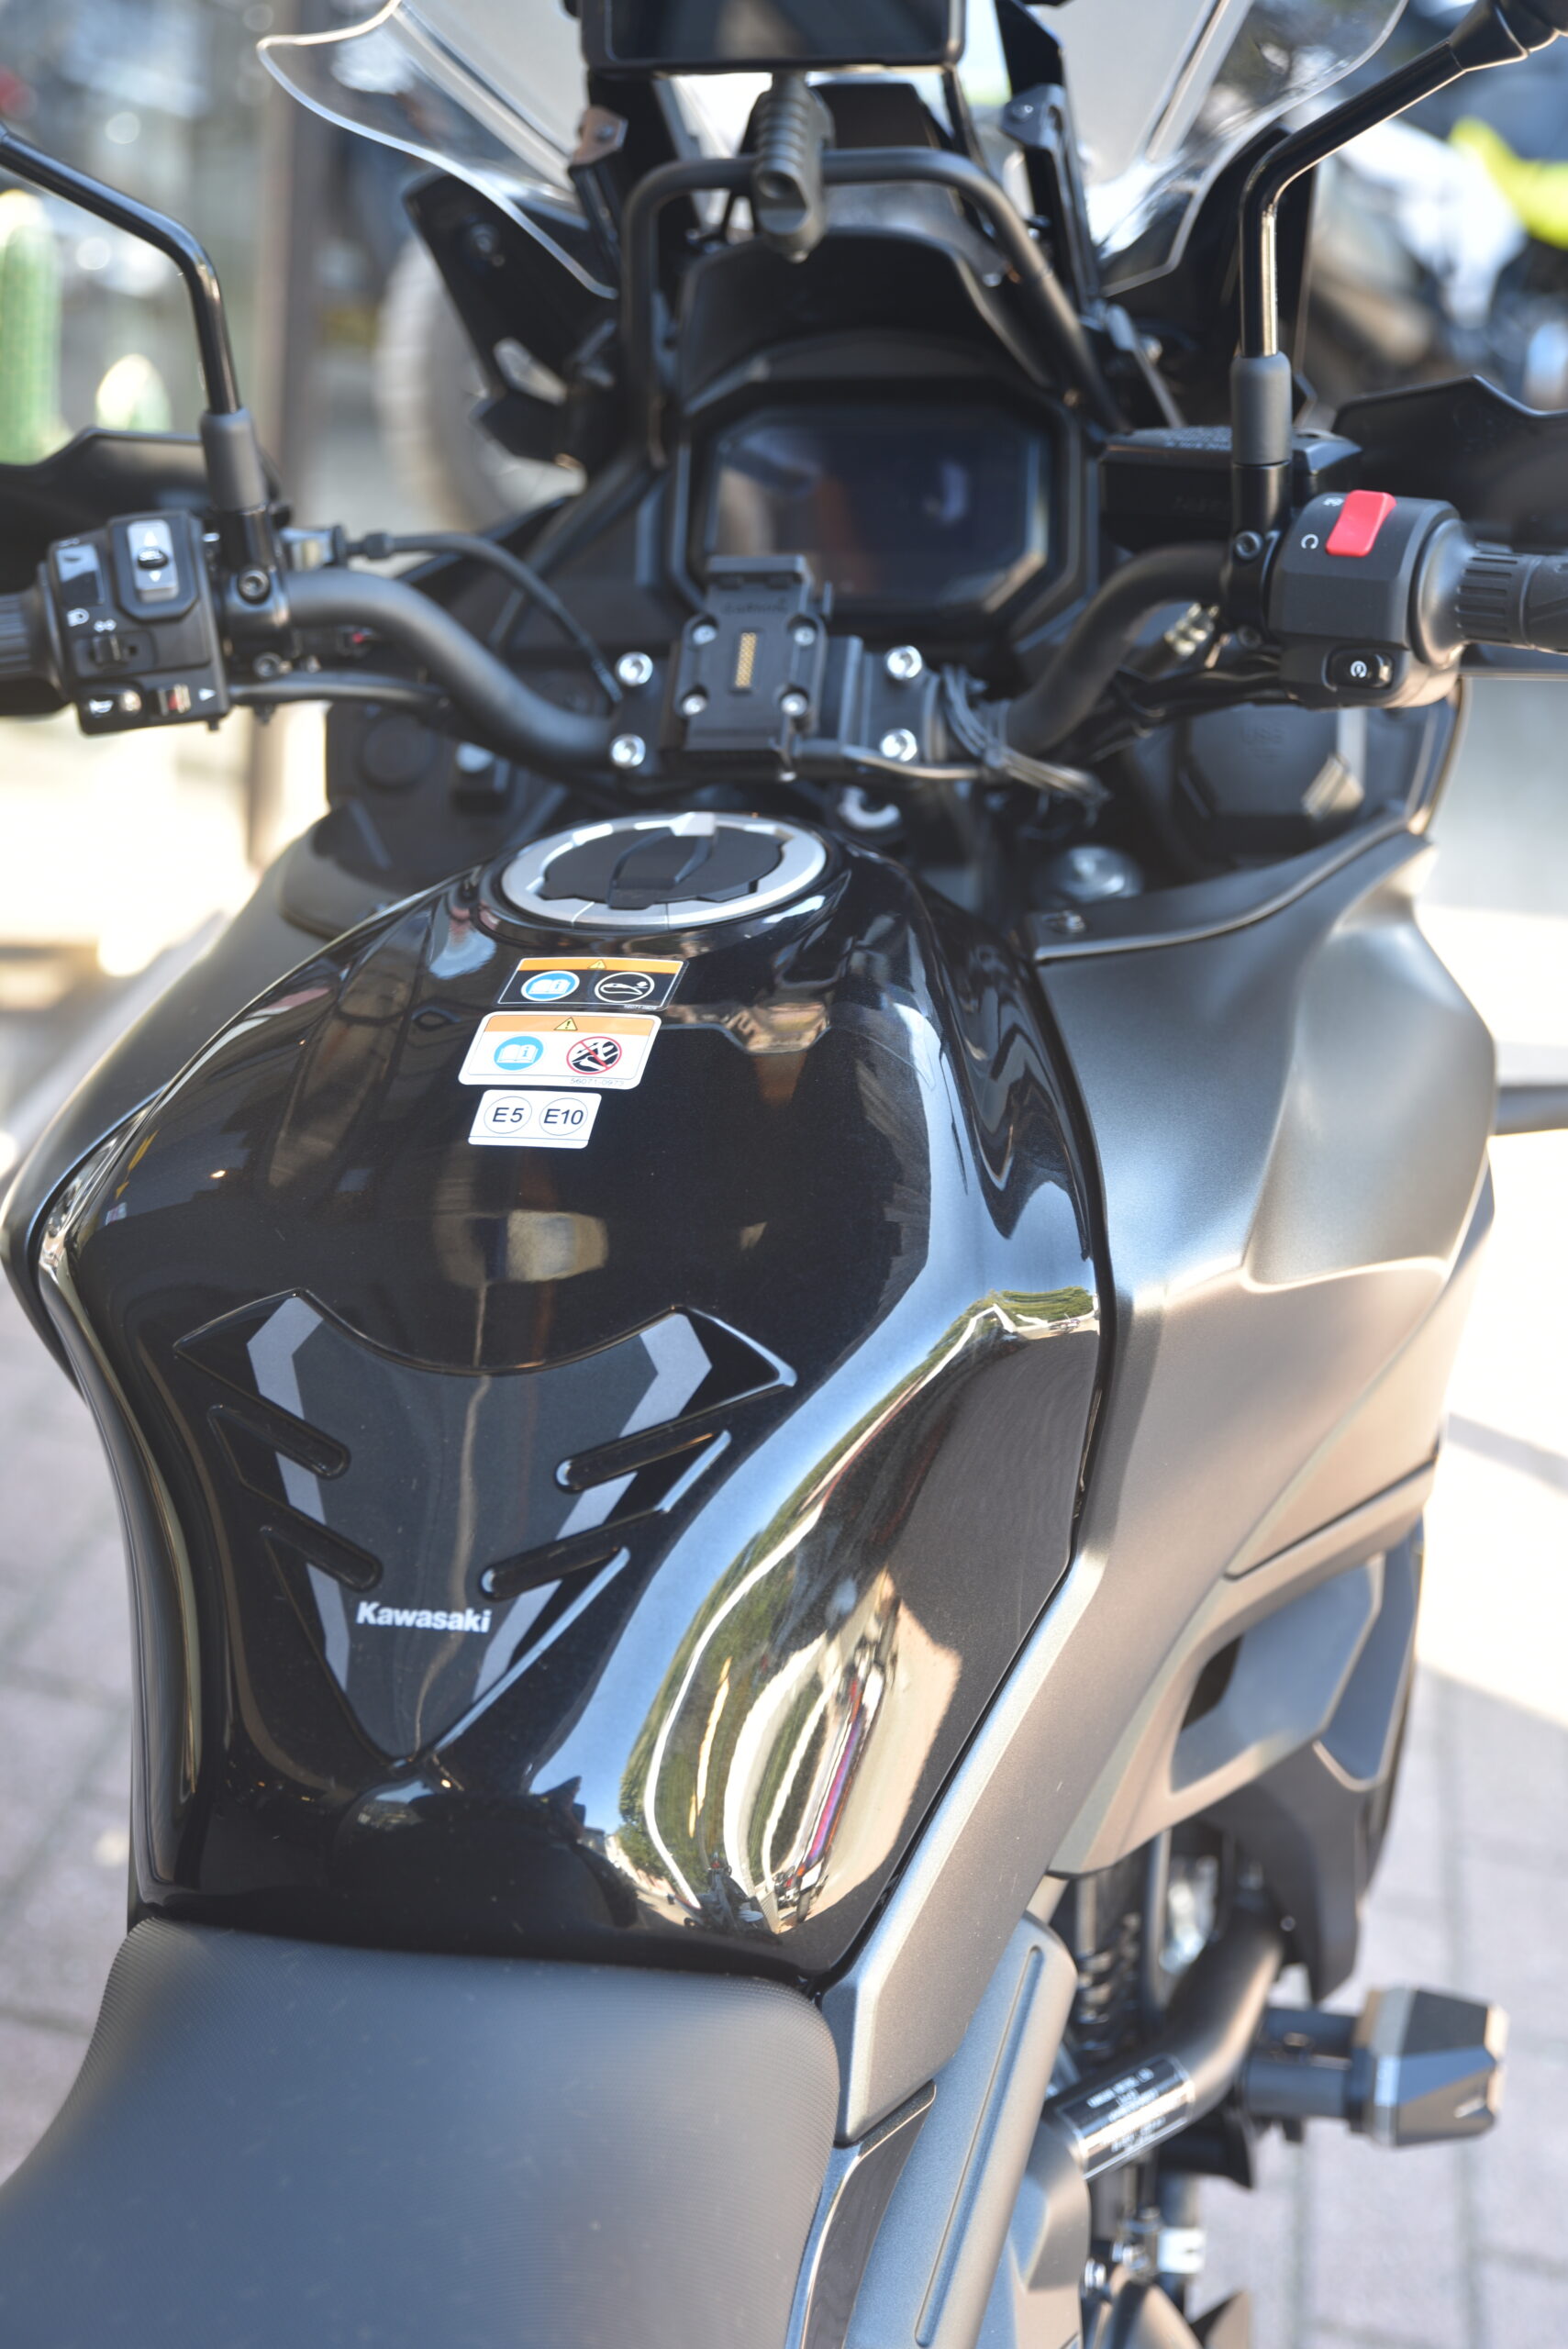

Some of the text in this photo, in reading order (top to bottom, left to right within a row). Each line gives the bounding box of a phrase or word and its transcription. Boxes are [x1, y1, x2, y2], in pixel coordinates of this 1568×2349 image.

[493, 1108, 584, 1124] E5 E10
[356, 1601, 492, 1633] Kawasaki
